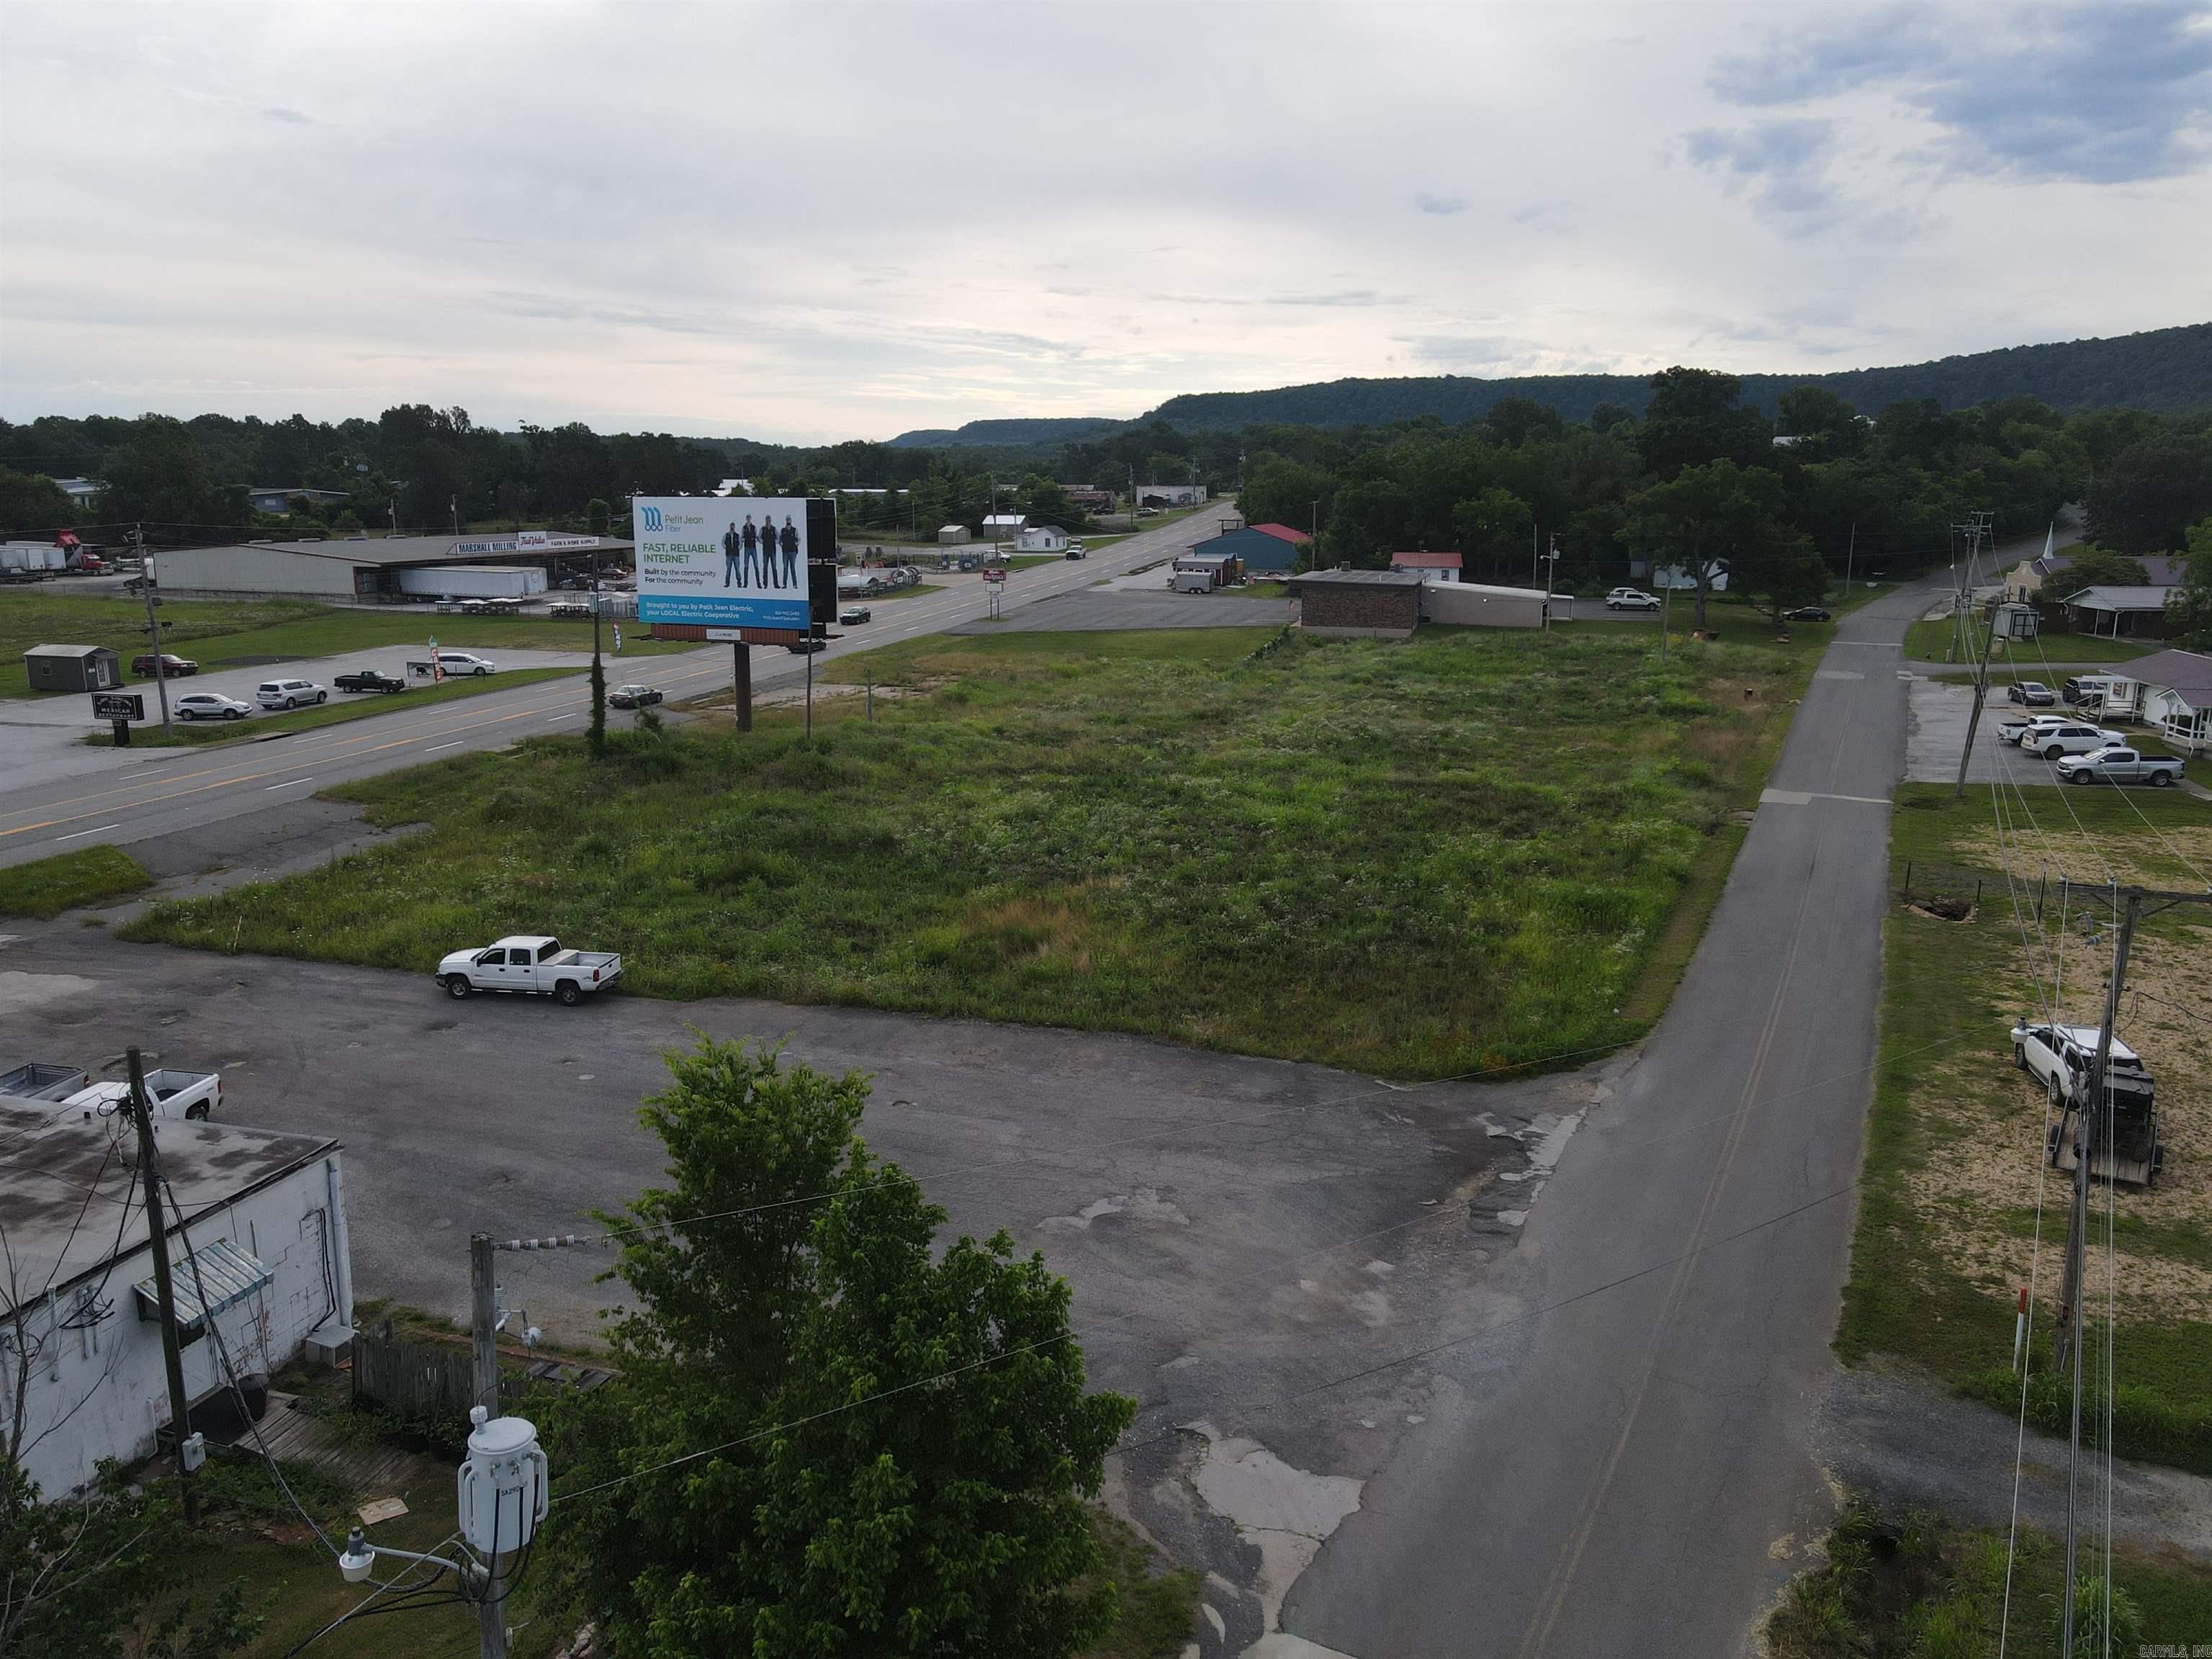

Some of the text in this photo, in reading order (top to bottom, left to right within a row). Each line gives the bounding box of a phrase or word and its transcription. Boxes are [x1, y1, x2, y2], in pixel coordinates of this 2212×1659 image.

[665, 514, 703, 524] Petit Jean
[459, 542, 517, 553] MARSHALL MILLING
[643, 543, 716, 553] FAST, RELIABLE
[644, 554, 690, 563] INTERNET
[431, 649, 441, 680] CARS
